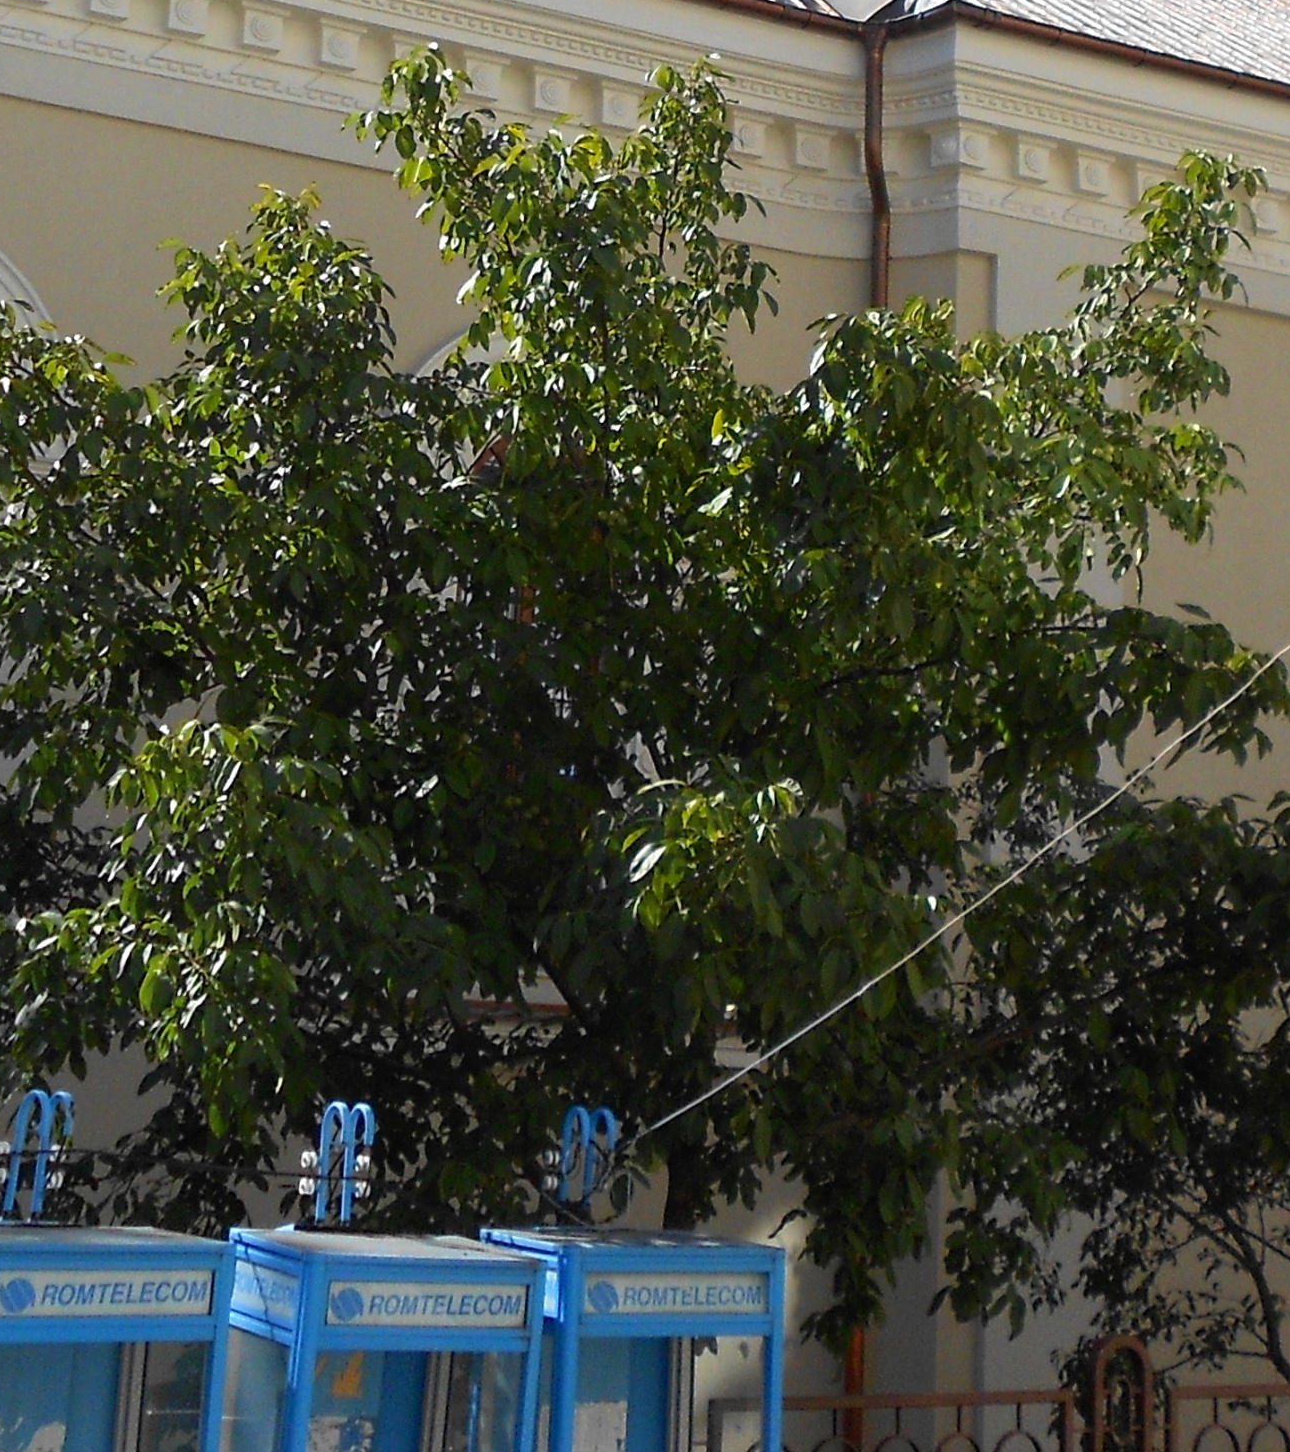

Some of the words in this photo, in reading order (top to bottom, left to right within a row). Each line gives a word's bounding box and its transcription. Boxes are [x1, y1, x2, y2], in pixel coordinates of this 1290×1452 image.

[42, 1281, 207, 1306] ROMTELECOM
[623, 1286, 762, 1307] ROMTELECOM
[369, 1295, 522, 1316] ROMTELECOM
